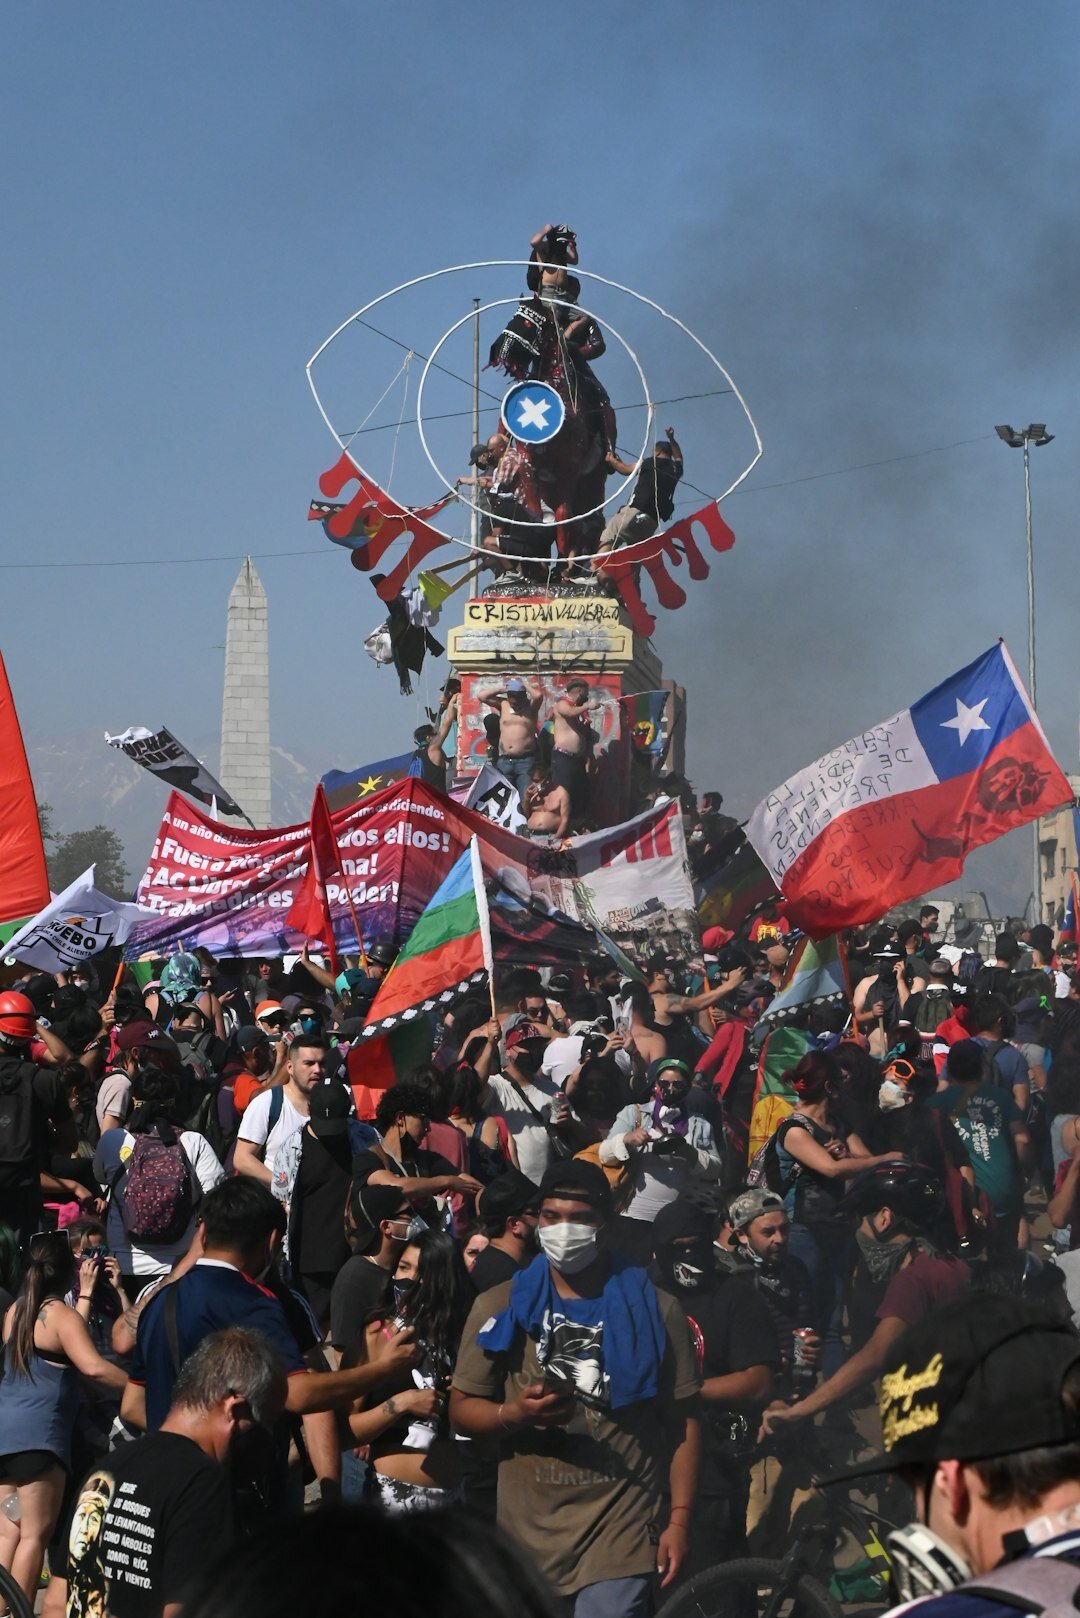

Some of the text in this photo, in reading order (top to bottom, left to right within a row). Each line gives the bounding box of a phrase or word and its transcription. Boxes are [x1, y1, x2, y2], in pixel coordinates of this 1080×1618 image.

[468, 603, 553, 623] CRISTIAN
[121, 730, 174, 757] UCHA
[162, 811, 171, 825] A
[173, 817, 189, 831] un
[189, 824, 213, 840] año
[388, 798, 445, 820] diciendo:
[151, 837, 226, 872] ¡Fuera
[383, 821, 451, 853] ellos!
[326, 881, 400, 905] Poder!
[121, 1499, 151, 1518] BOSQUES
[114, 1514, 155, 1539] LEVANTAMOS
[121, 1533, 152, 1555] ÁRBOLES
[133, 1555, 149, 1572] RÍO,
[116, 1569, 124, 1581] Y
[125, 1571, 152, 1590] VIENTO.
